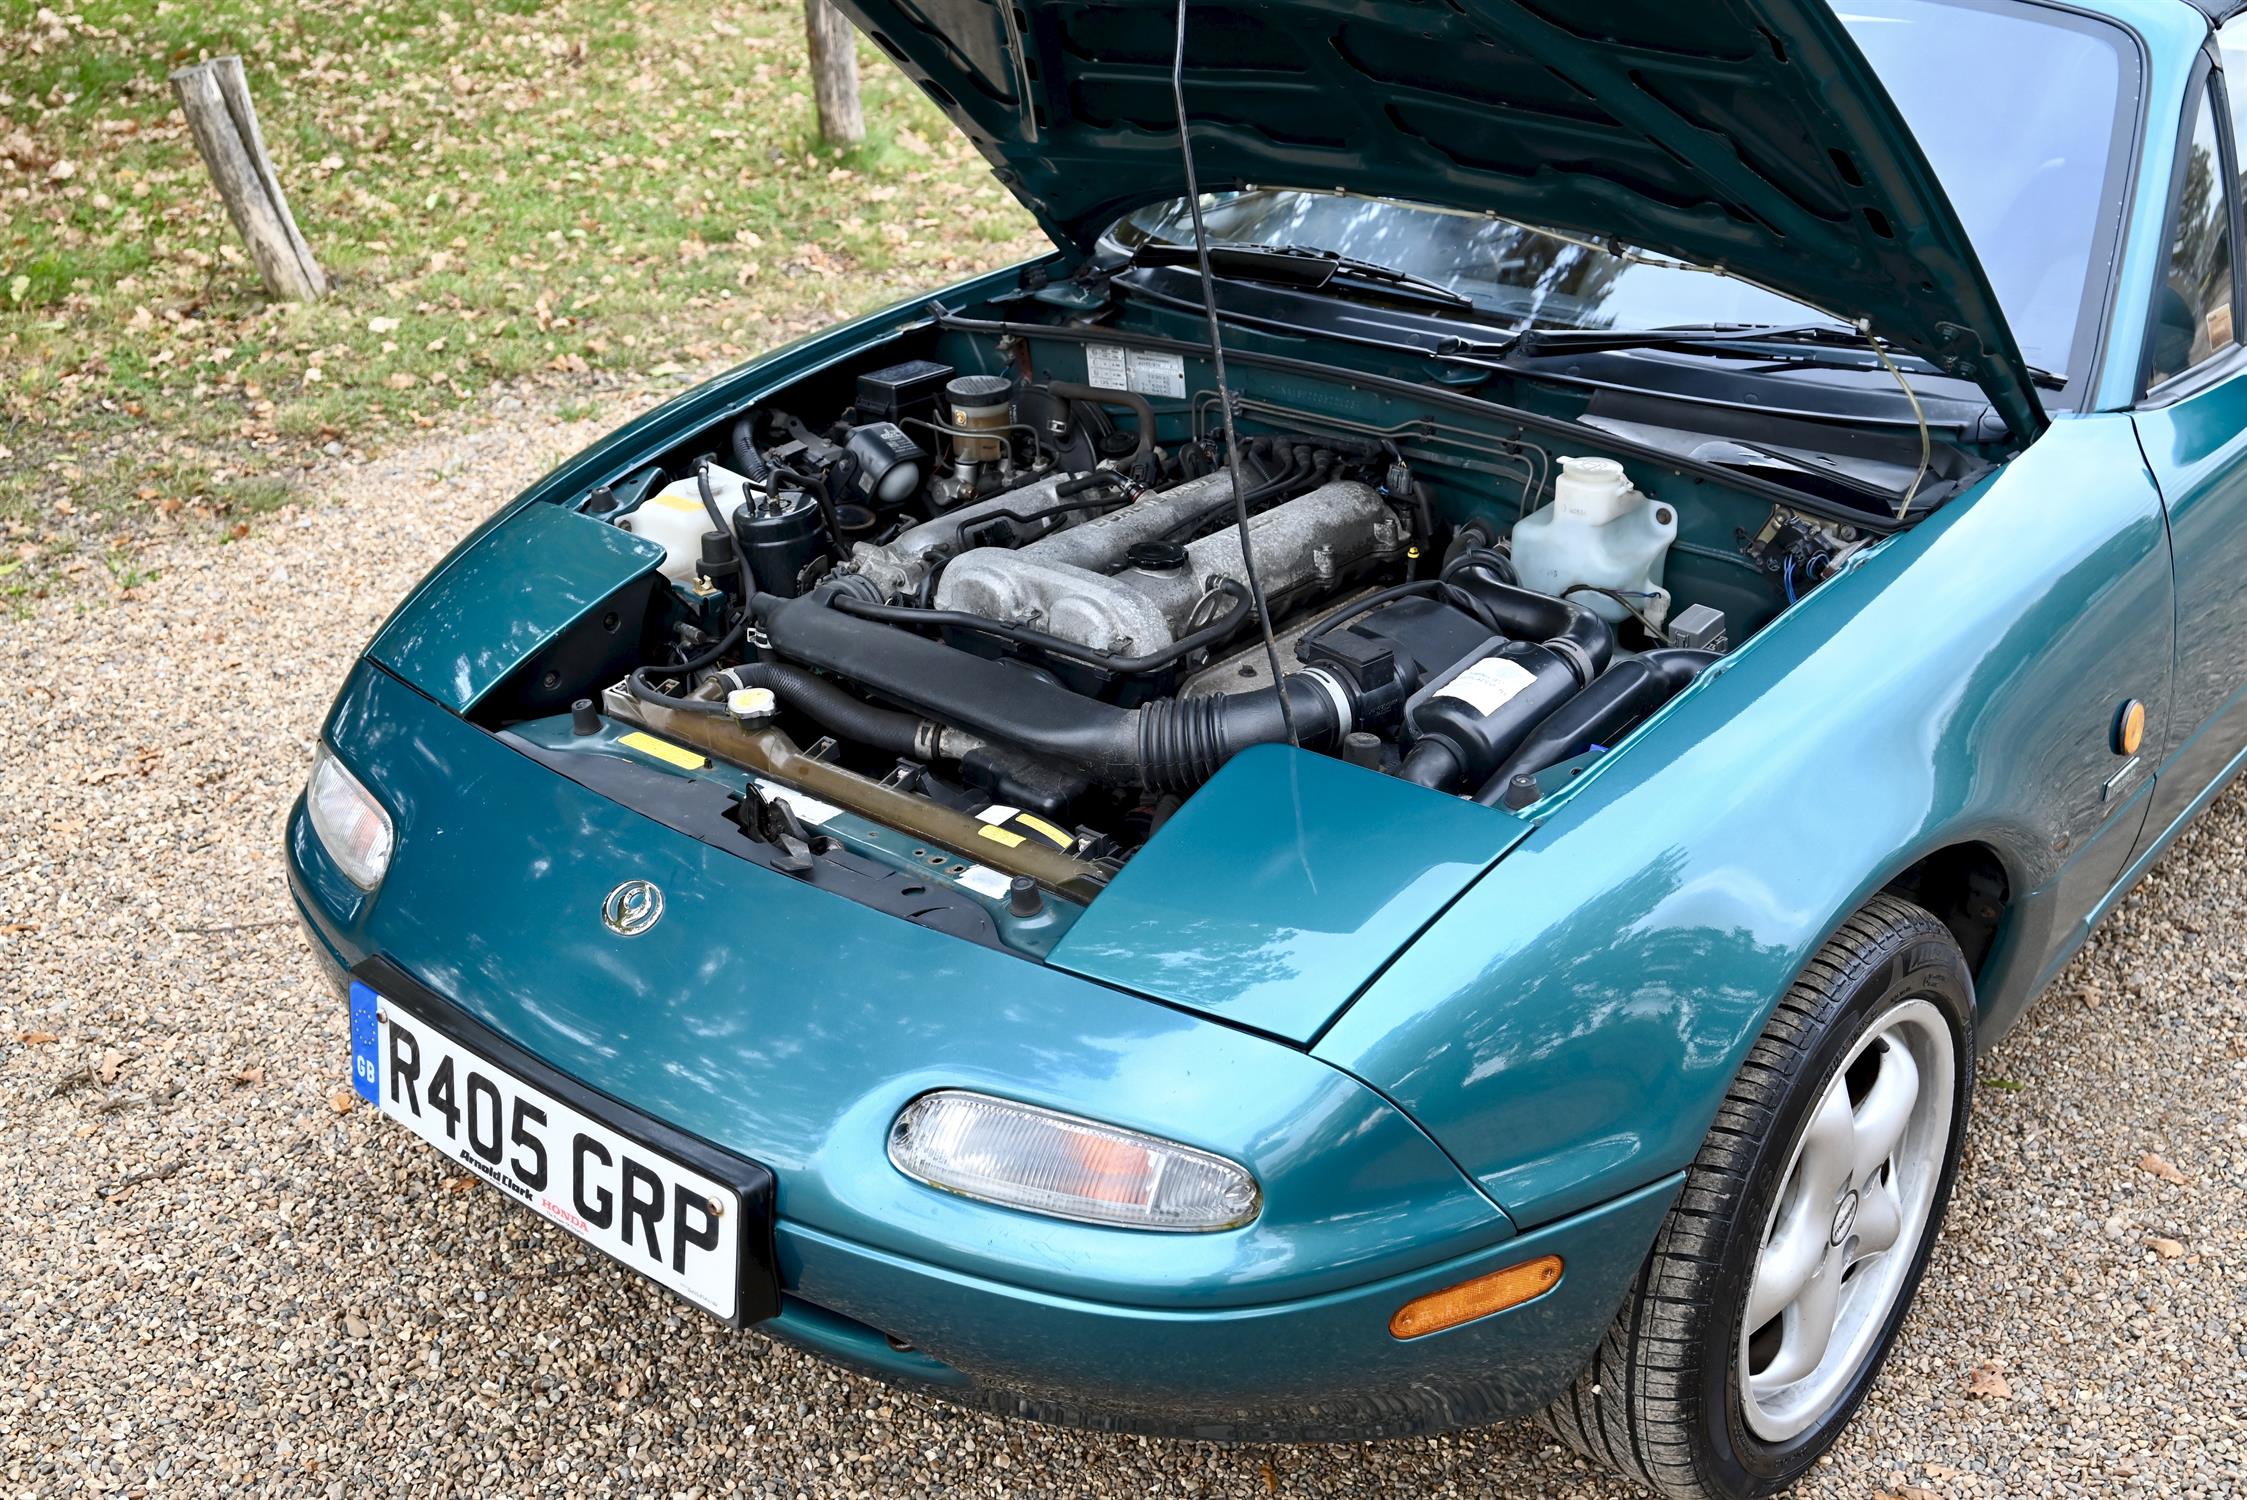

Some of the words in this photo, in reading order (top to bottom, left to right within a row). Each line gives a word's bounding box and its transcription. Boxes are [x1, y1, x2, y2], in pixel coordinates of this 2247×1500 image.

[356, 1054, 376, 1084] GB
[388, 1018, 548, 1193] R405
[572, 1132, 720, 1276] GRP
[459, 1149, 501, 1182] Arnold
[501, 1174, 534, 1202] Clark
[541, 1197, 590, 1233] HONDA
